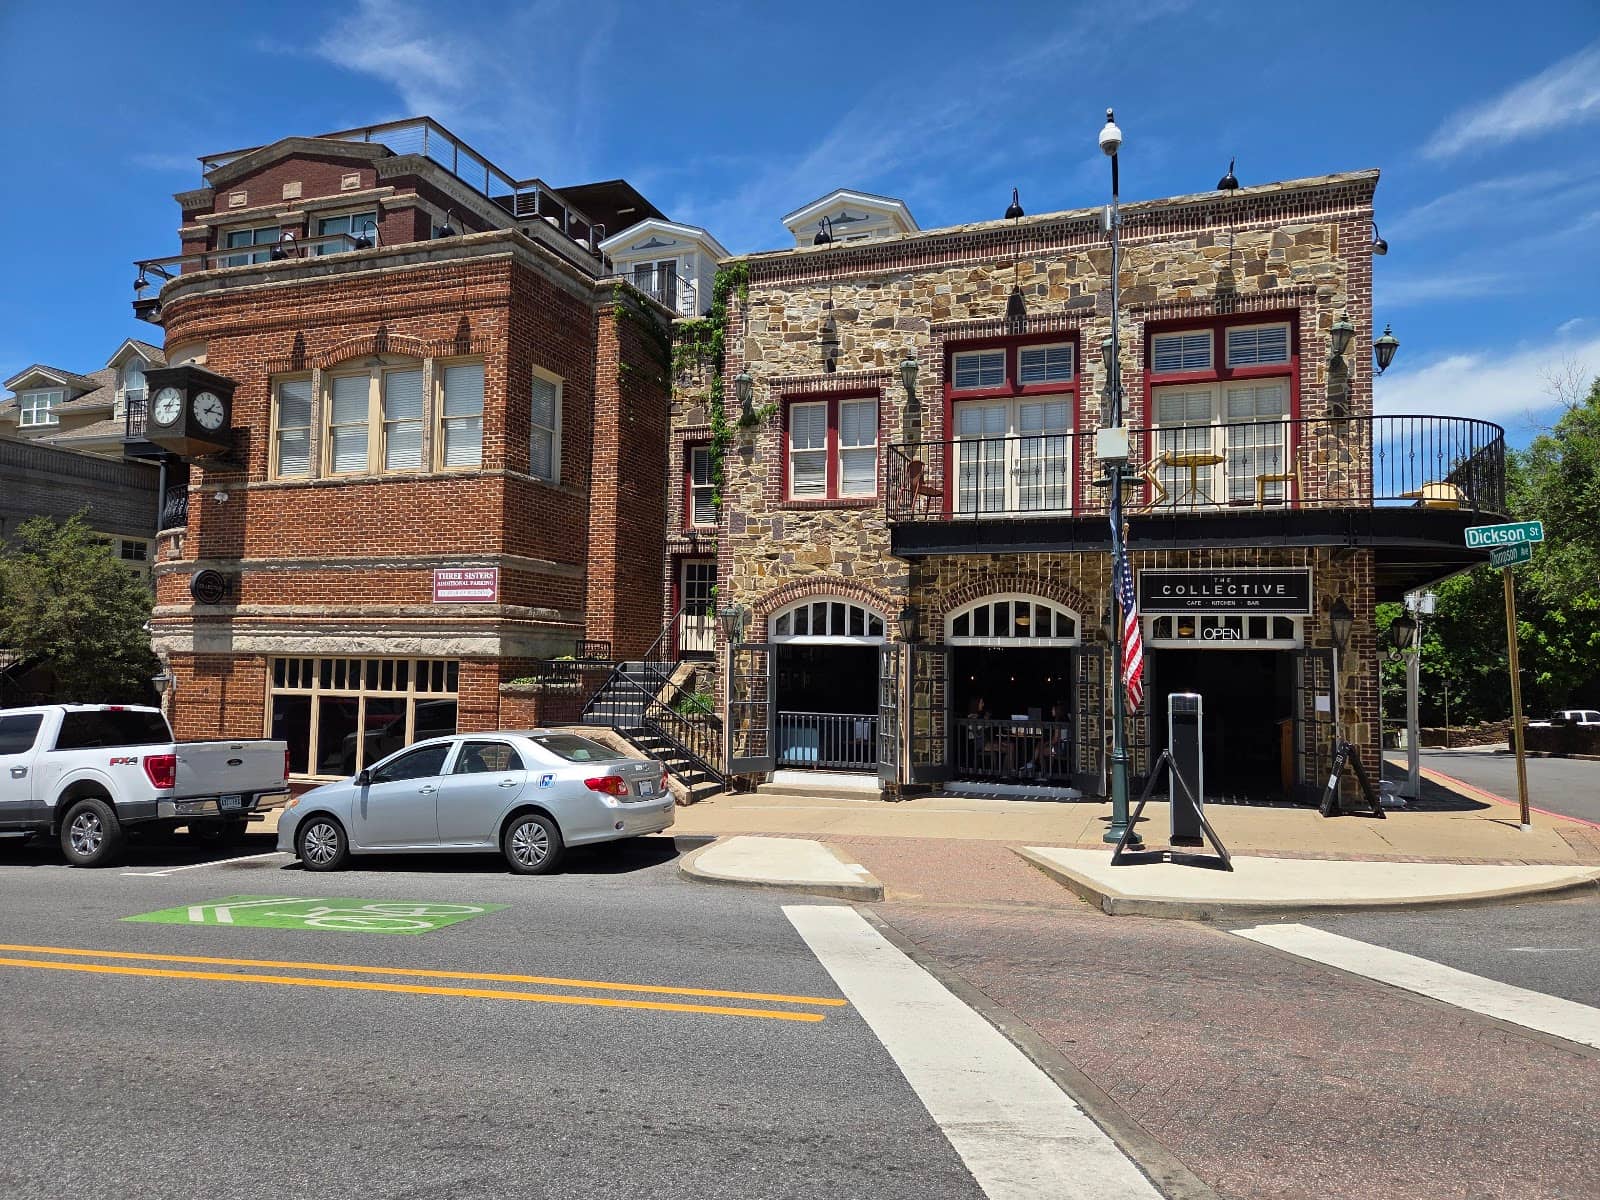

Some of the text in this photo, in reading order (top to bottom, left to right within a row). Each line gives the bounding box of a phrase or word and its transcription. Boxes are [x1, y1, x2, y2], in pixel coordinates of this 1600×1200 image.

[1468, 527, 1539, 545] Dickson St
[464, 571, 494, 579] SISTERS
[1162, 584, 1287, 595] COLLECTIVE
[1203, 627, 1240, 640] OPEN
[109, 756, 138, 766] FX4
